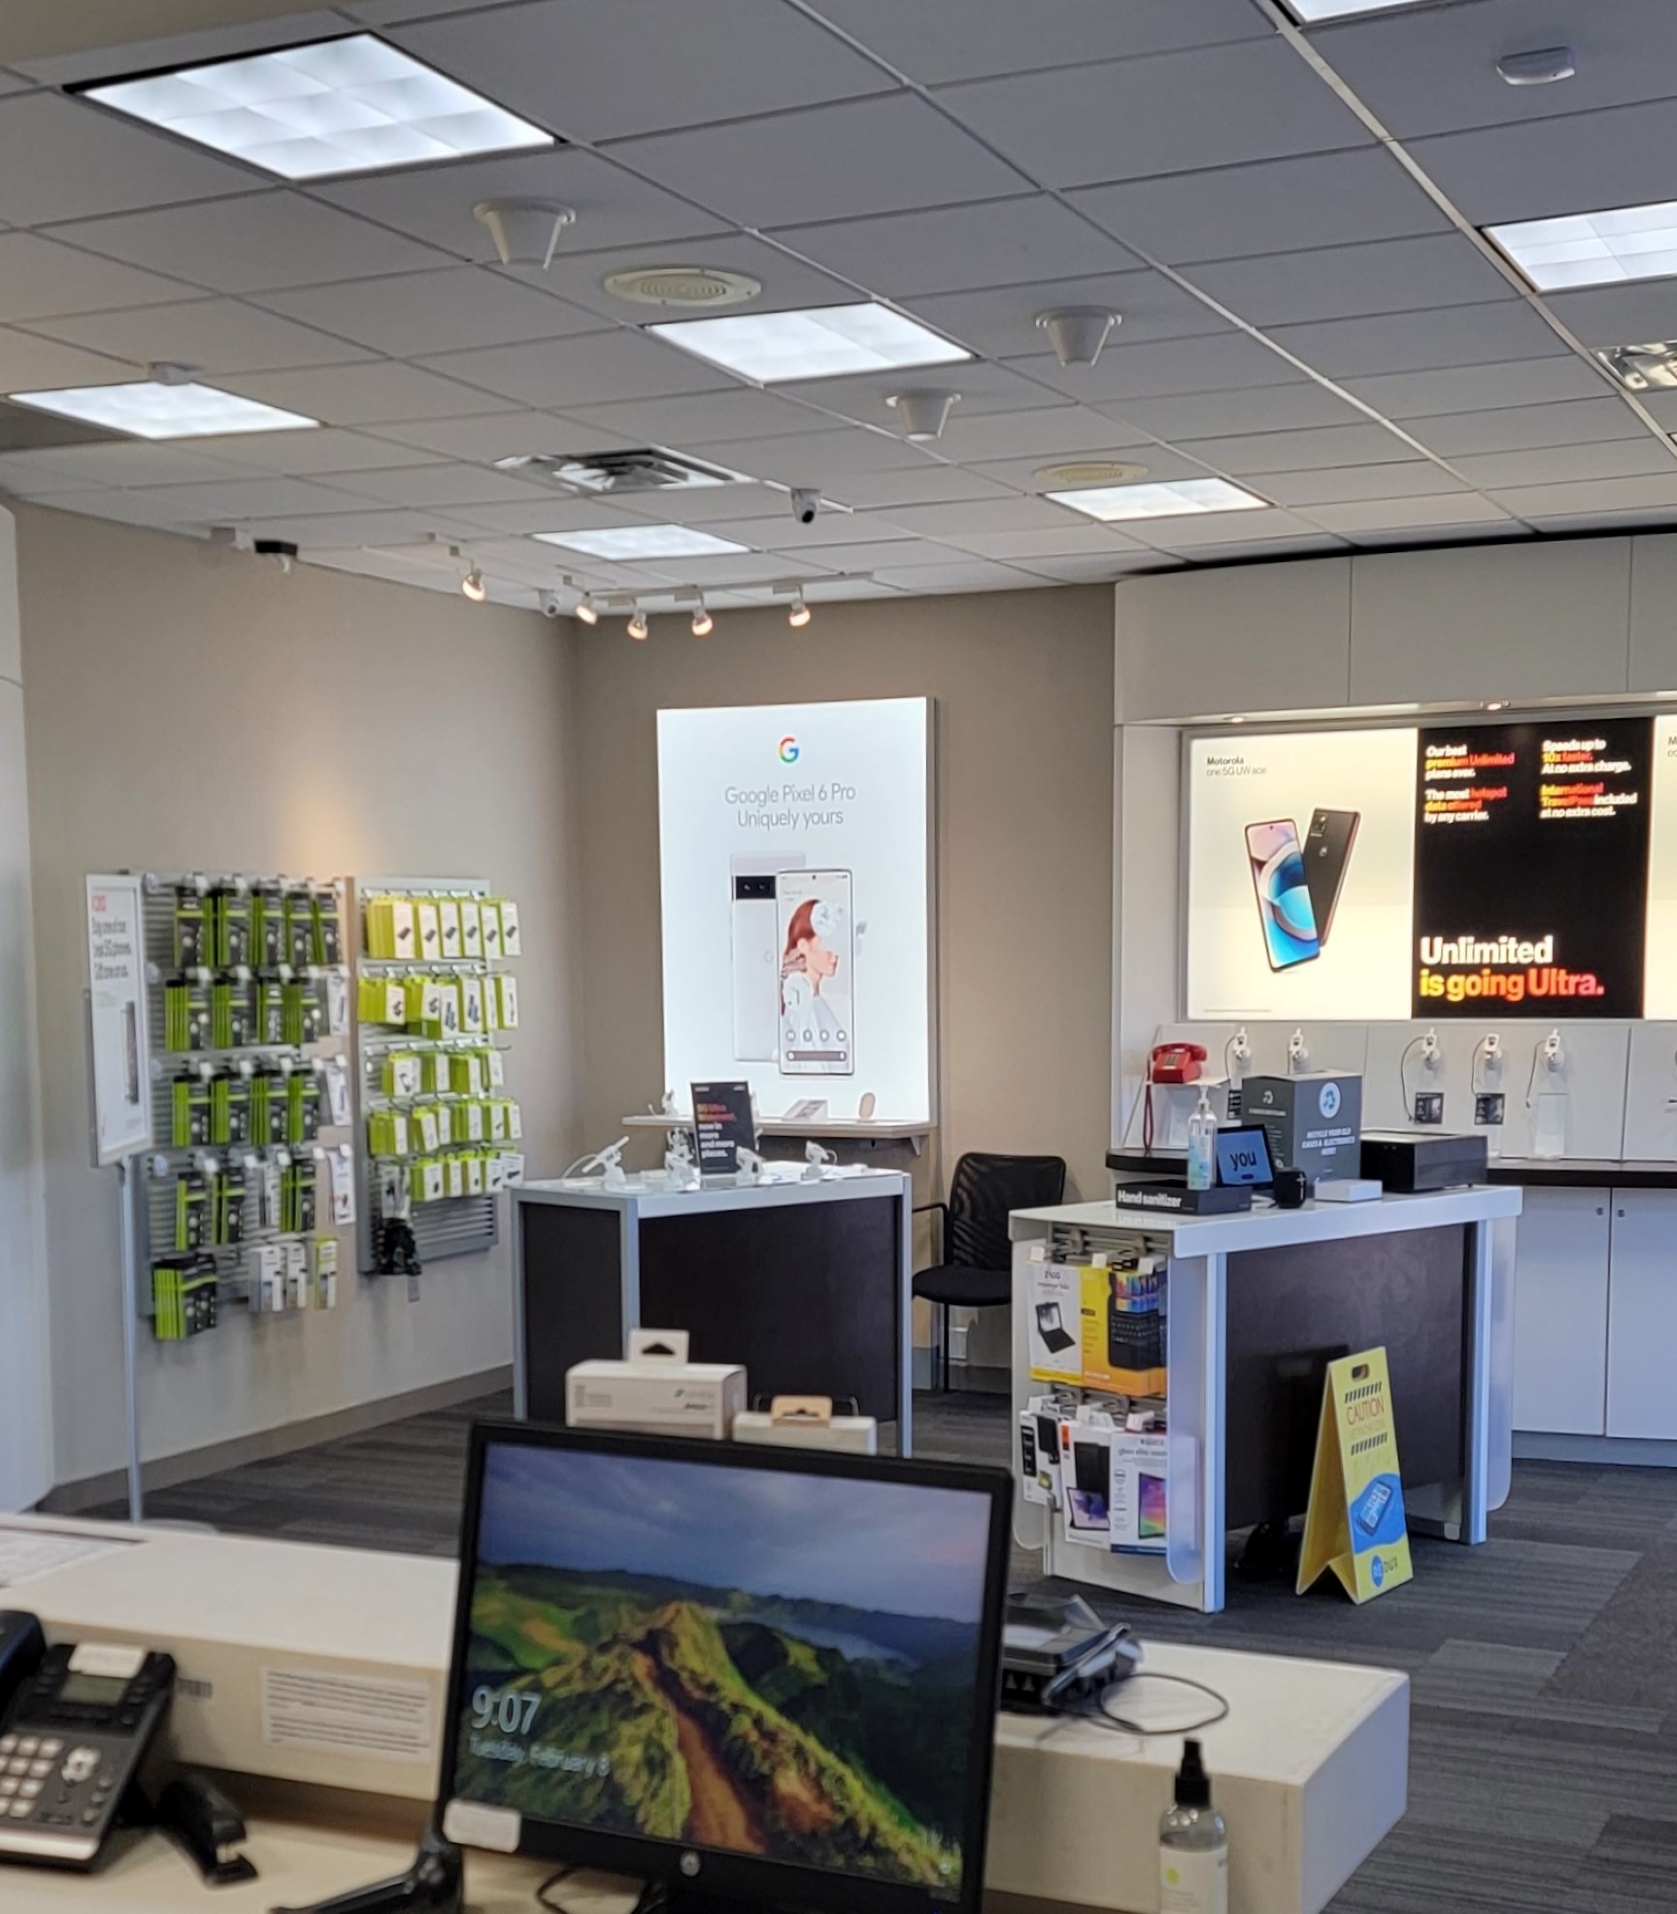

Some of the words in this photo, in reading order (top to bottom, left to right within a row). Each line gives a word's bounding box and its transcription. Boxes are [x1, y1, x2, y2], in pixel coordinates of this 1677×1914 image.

[1425, 745, 1445, 757] Our
[1446, 744, 1467, 757] best
[1542, 739, 1580, 752] Speeds
[1581, 741, 1594, 752] up
[1594, 738, 1606, 750] to
[1207, 756, 1244, 765] Motorola
[1469, 752, 1515, 766] Unlimited
[1555, 764, 1568, 774] no
[1568, 762, 1594, 774] extra
[724, 786, 779, 808] Google
[782, 783, 815, 803] Pixel
[818, 784, 828, 801] 6
[831, 782, 856, 801] Pro
[1424, 788, 1445, 800] The
[1445, 788, 1470, 800] most
[1593, 792, 1638, 806] included
[737, 808, 800, 832] Uniquely
[803, 810, 844, 831] yours
[1424, 811, 1437, 824] by
[1437, 813, 1455, 824] any
[1552, 808, 1565, 818] no
[1565, 806, 1591, 818] extra
[1420, 935, 1554, 965] Unlimited
[1419, 968, 1445, 997] is
[1446, 968, 1525, 1002] going
[1527, 967, 1605, 997] Ultra.
[1230, 1151, 1257, 1172] you
[1117, 1189, 1143, 1205] Hand
[1143, 1191, 1182, 1208] sanitizer
[1346, 1395, 1385, 1426] CAUTION
[471, 1684, 542, 1736] 9:07
[529, 1744, 597, 1779] February
